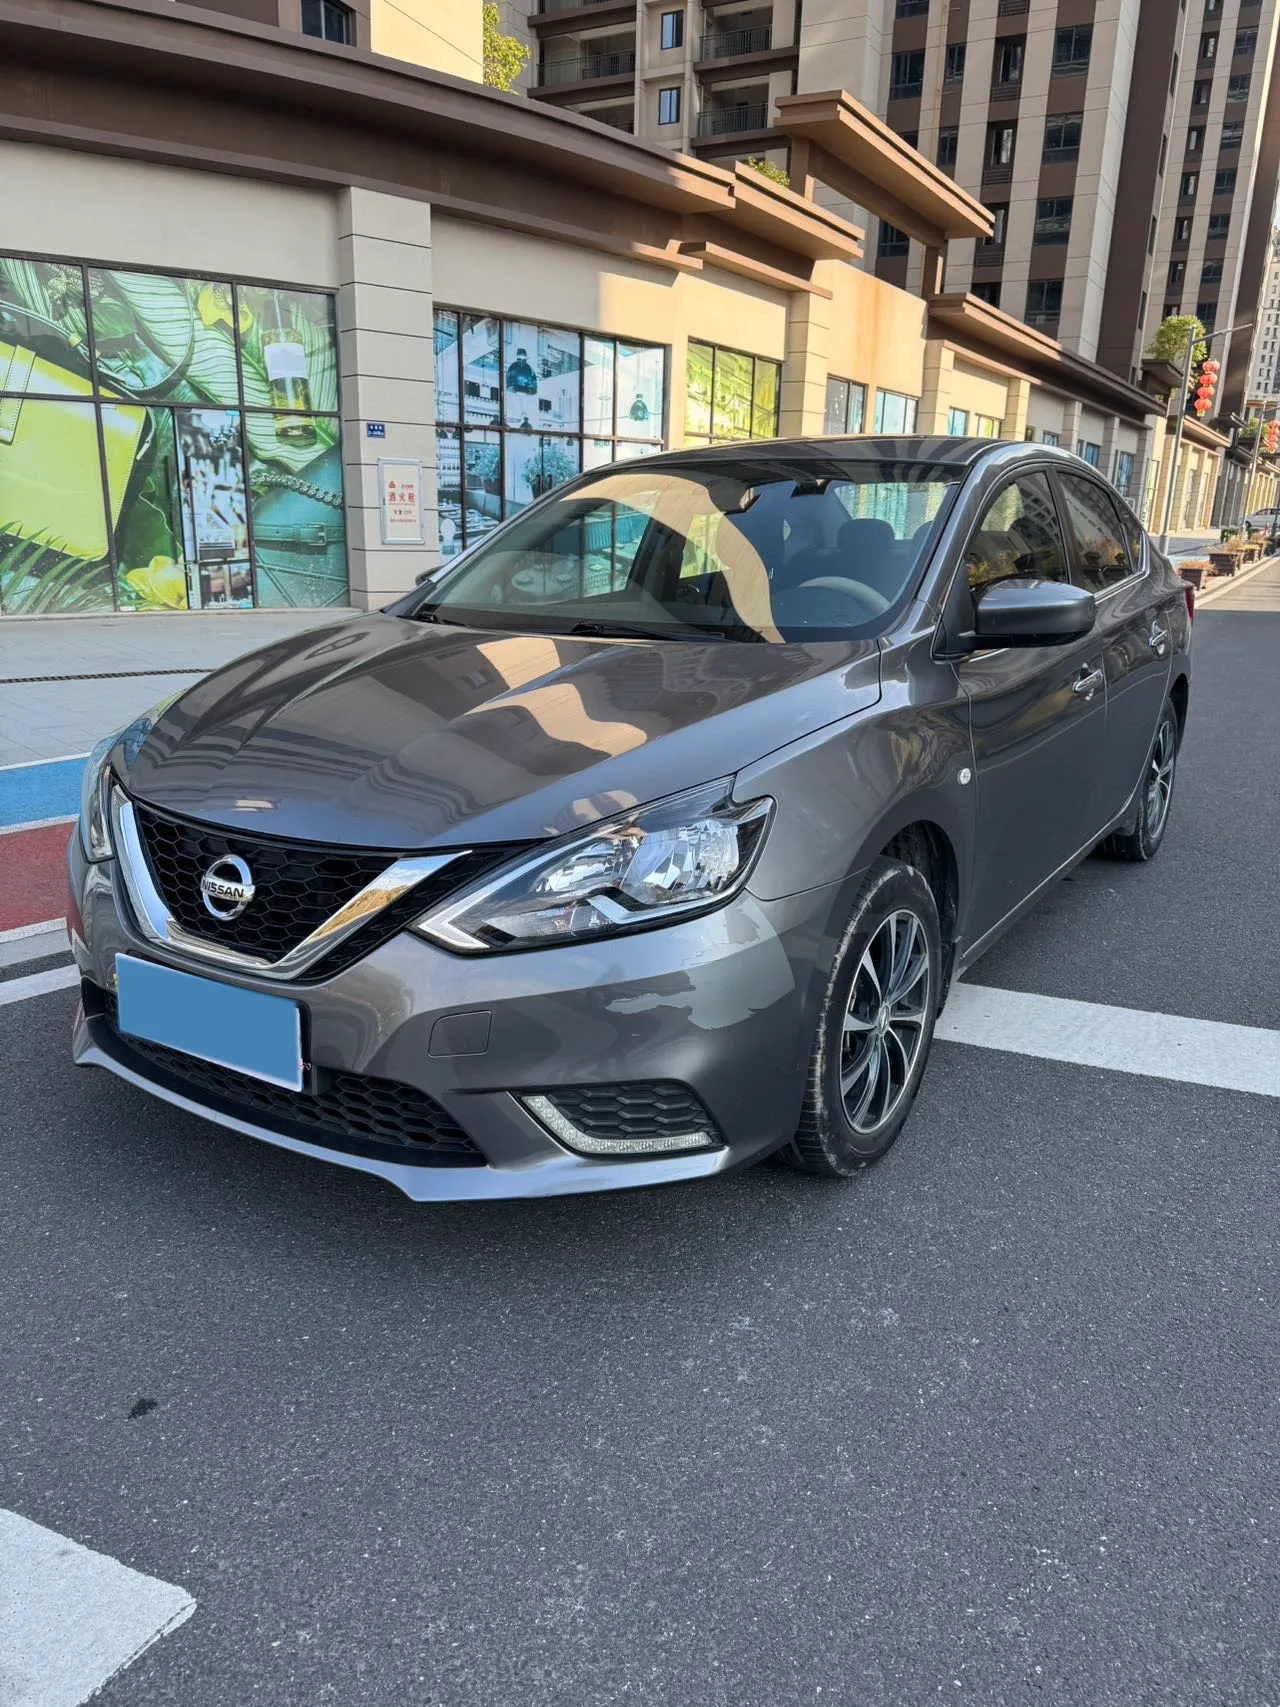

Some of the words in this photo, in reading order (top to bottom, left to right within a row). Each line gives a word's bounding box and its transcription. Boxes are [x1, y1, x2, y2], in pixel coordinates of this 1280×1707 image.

[389, 492, 415, 502] 消火栓
[202, 879, 244, 898] NISSAN
